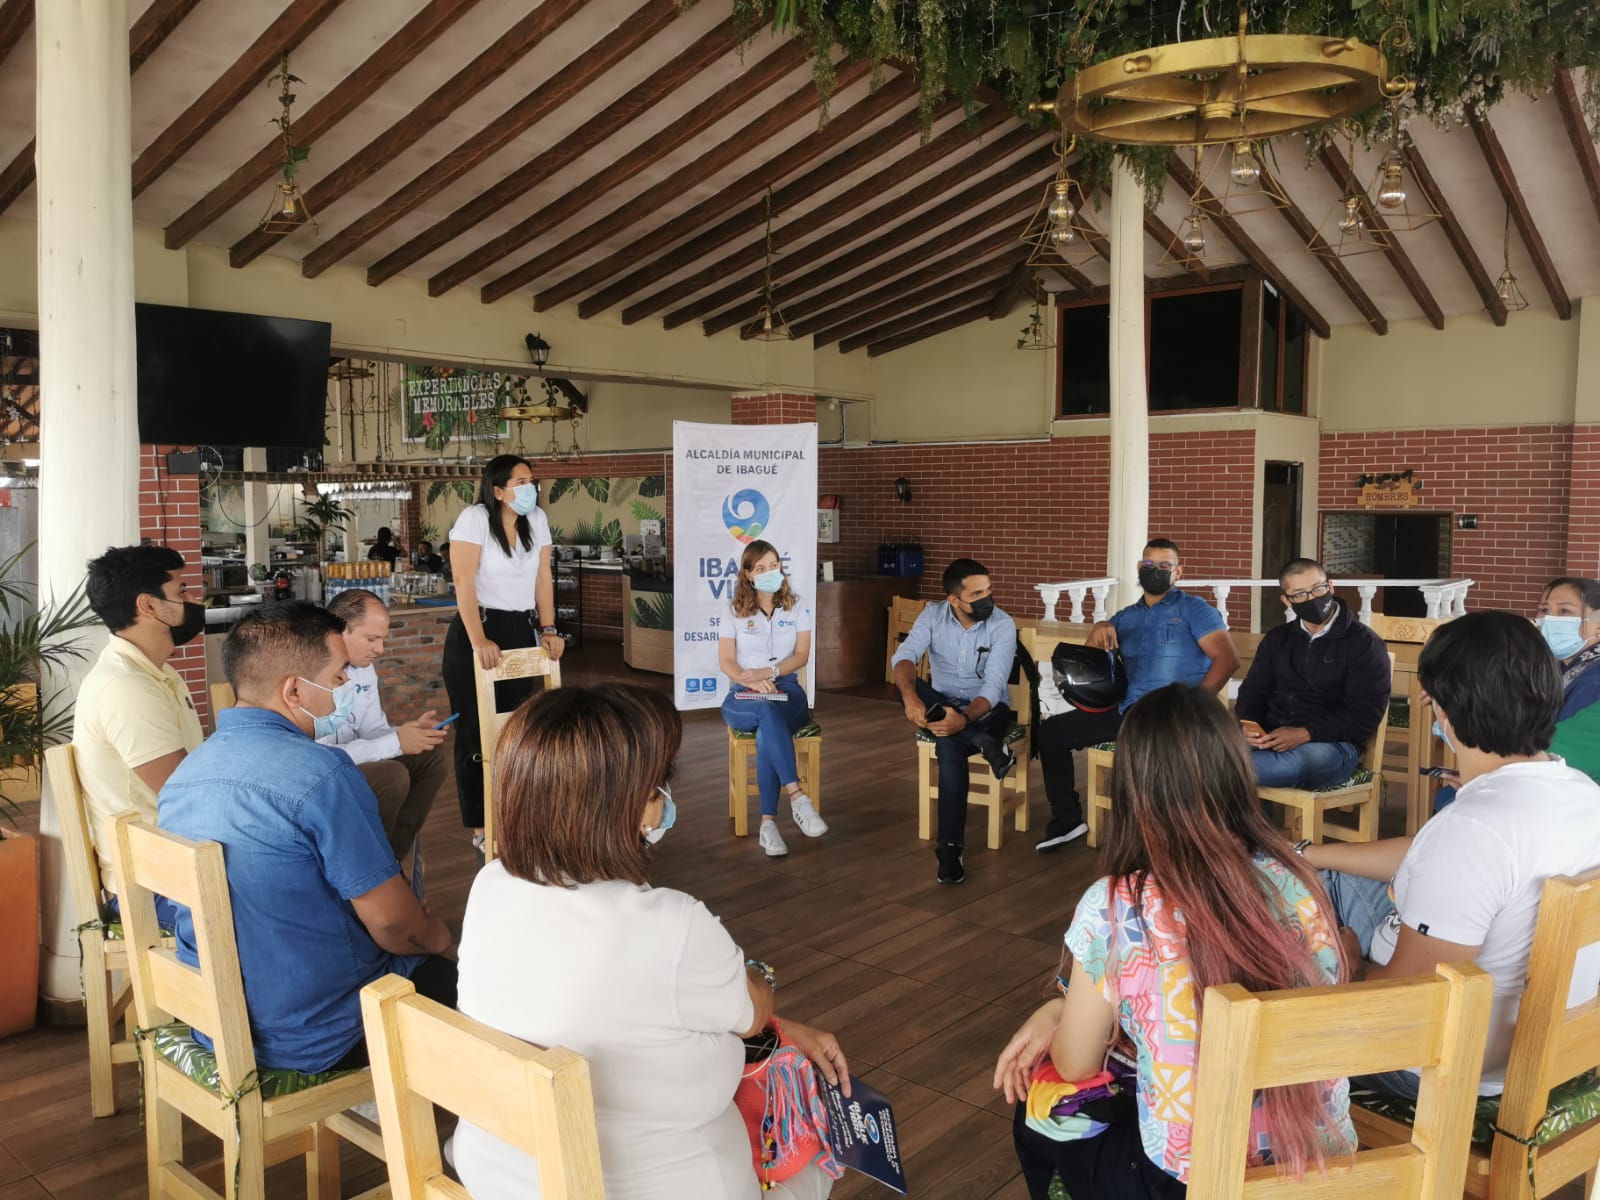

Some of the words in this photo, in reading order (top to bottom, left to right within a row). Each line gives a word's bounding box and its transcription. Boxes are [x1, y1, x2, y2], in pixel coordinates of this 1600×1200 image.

[408, 373, 501, 396] EXPERIENCIAS
[413, 392, 496, 414] MEMORABLES
[686, 448, 740, 460] ALCALDÍA
[743, 450, 805, 460] MUNICIPAL
[717, 465, 732, 474] DE
[736, 464, 778, 475] IBAGUÉ
[1365, 491, 1409, 502] HOMBRES
